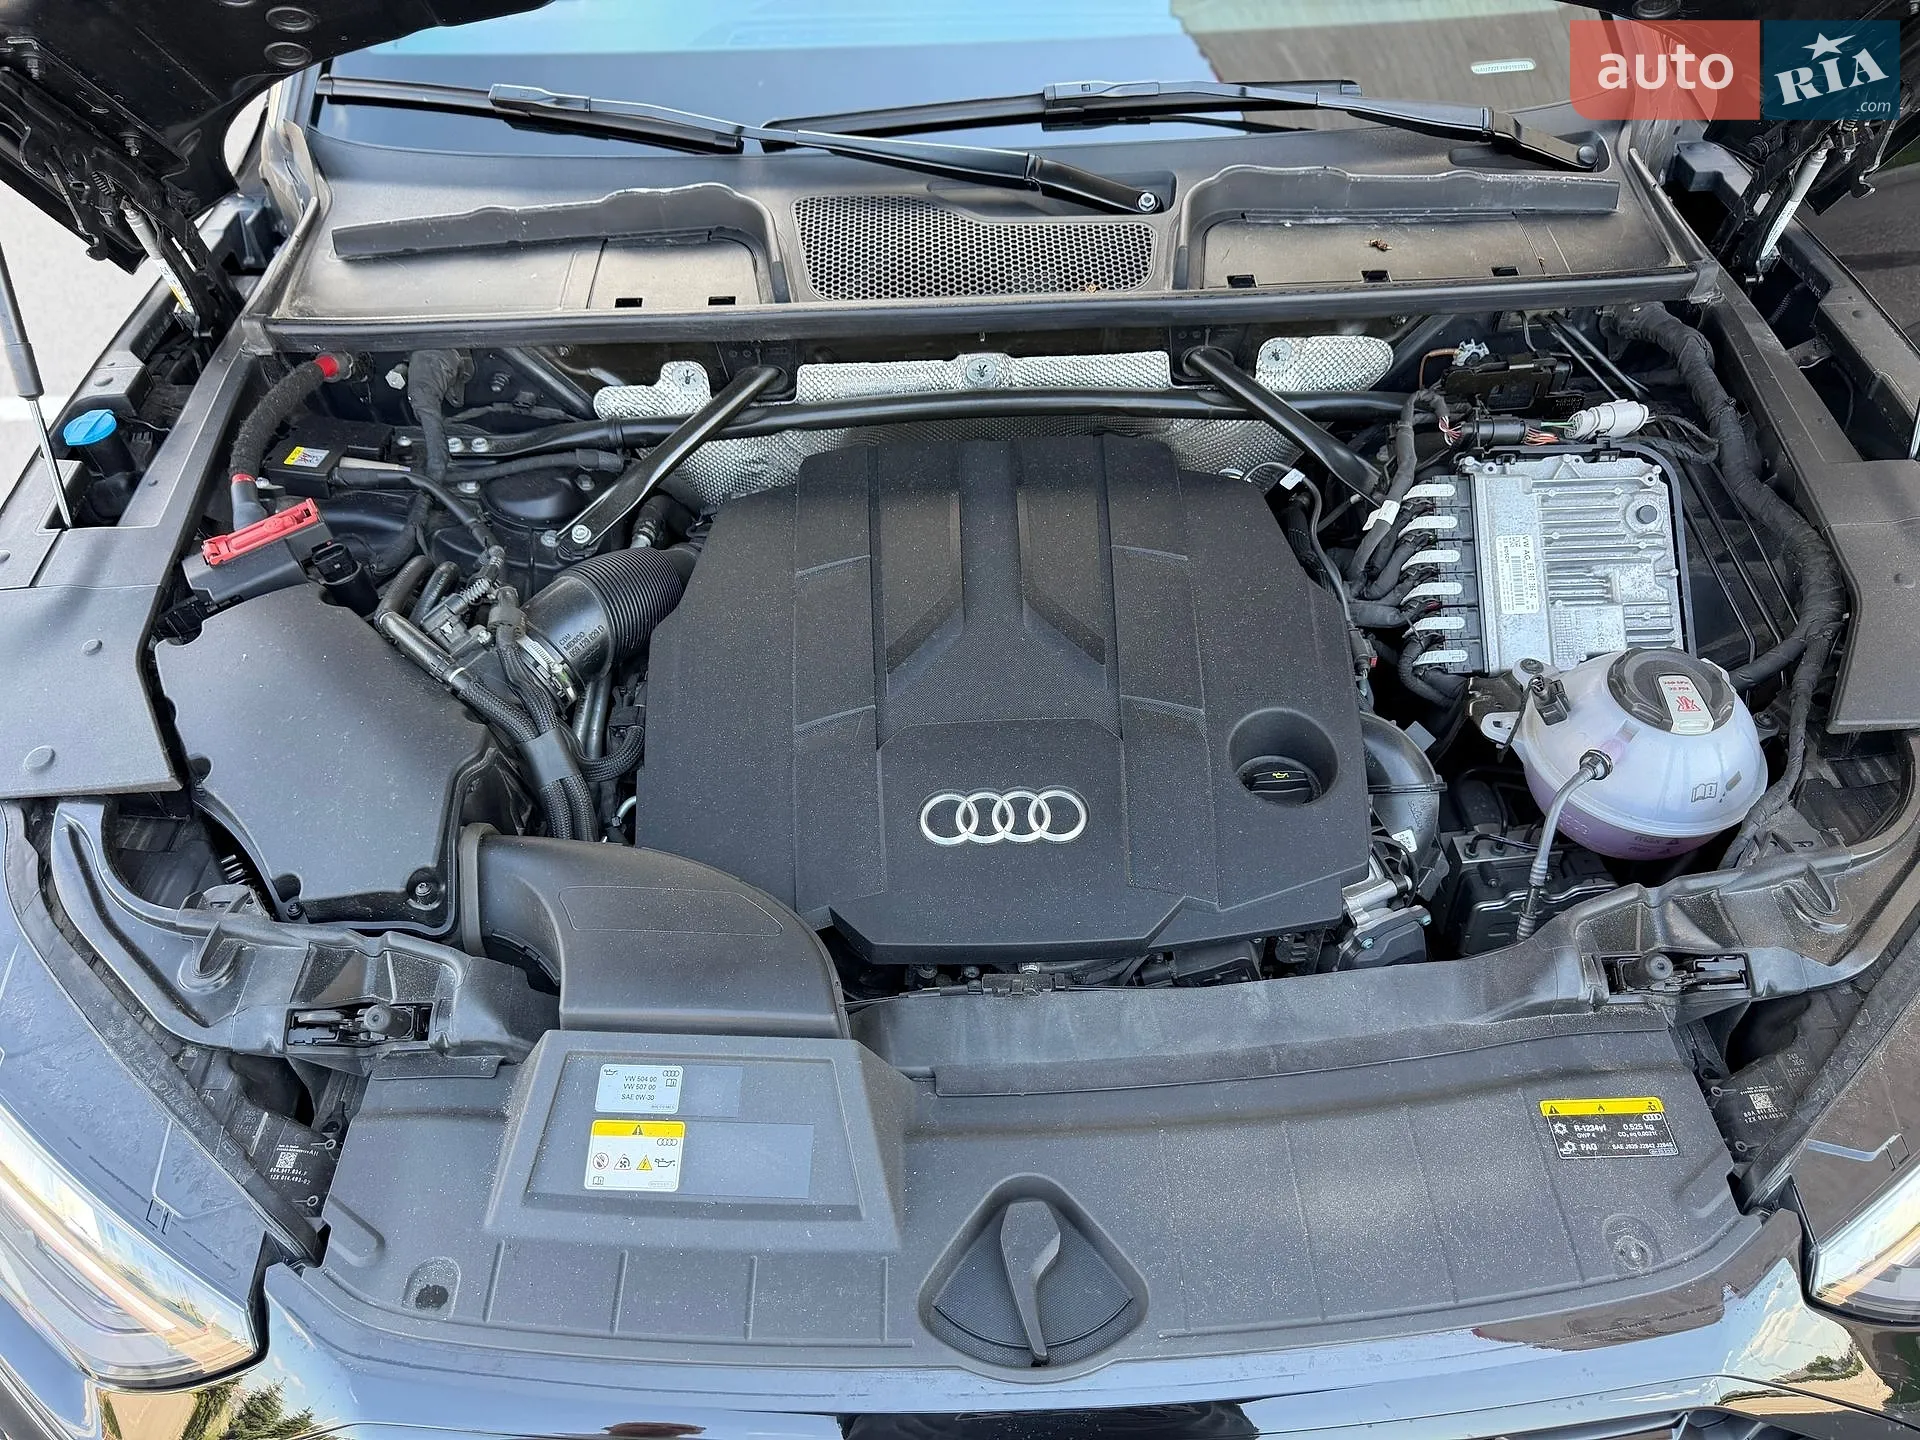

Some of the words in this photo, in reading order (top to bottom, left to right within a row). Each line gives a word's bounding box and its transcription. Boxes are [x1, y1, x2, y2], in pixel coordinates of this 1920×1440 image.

[1522, 535, 1531, 548] VW
[1524, 549, 1531, 560] AG
[563, 631, 586, 651] MEXICO
[1644, 1123, 1655, 1131] kg
[1580, 1143, 1598, 1151] PAG
